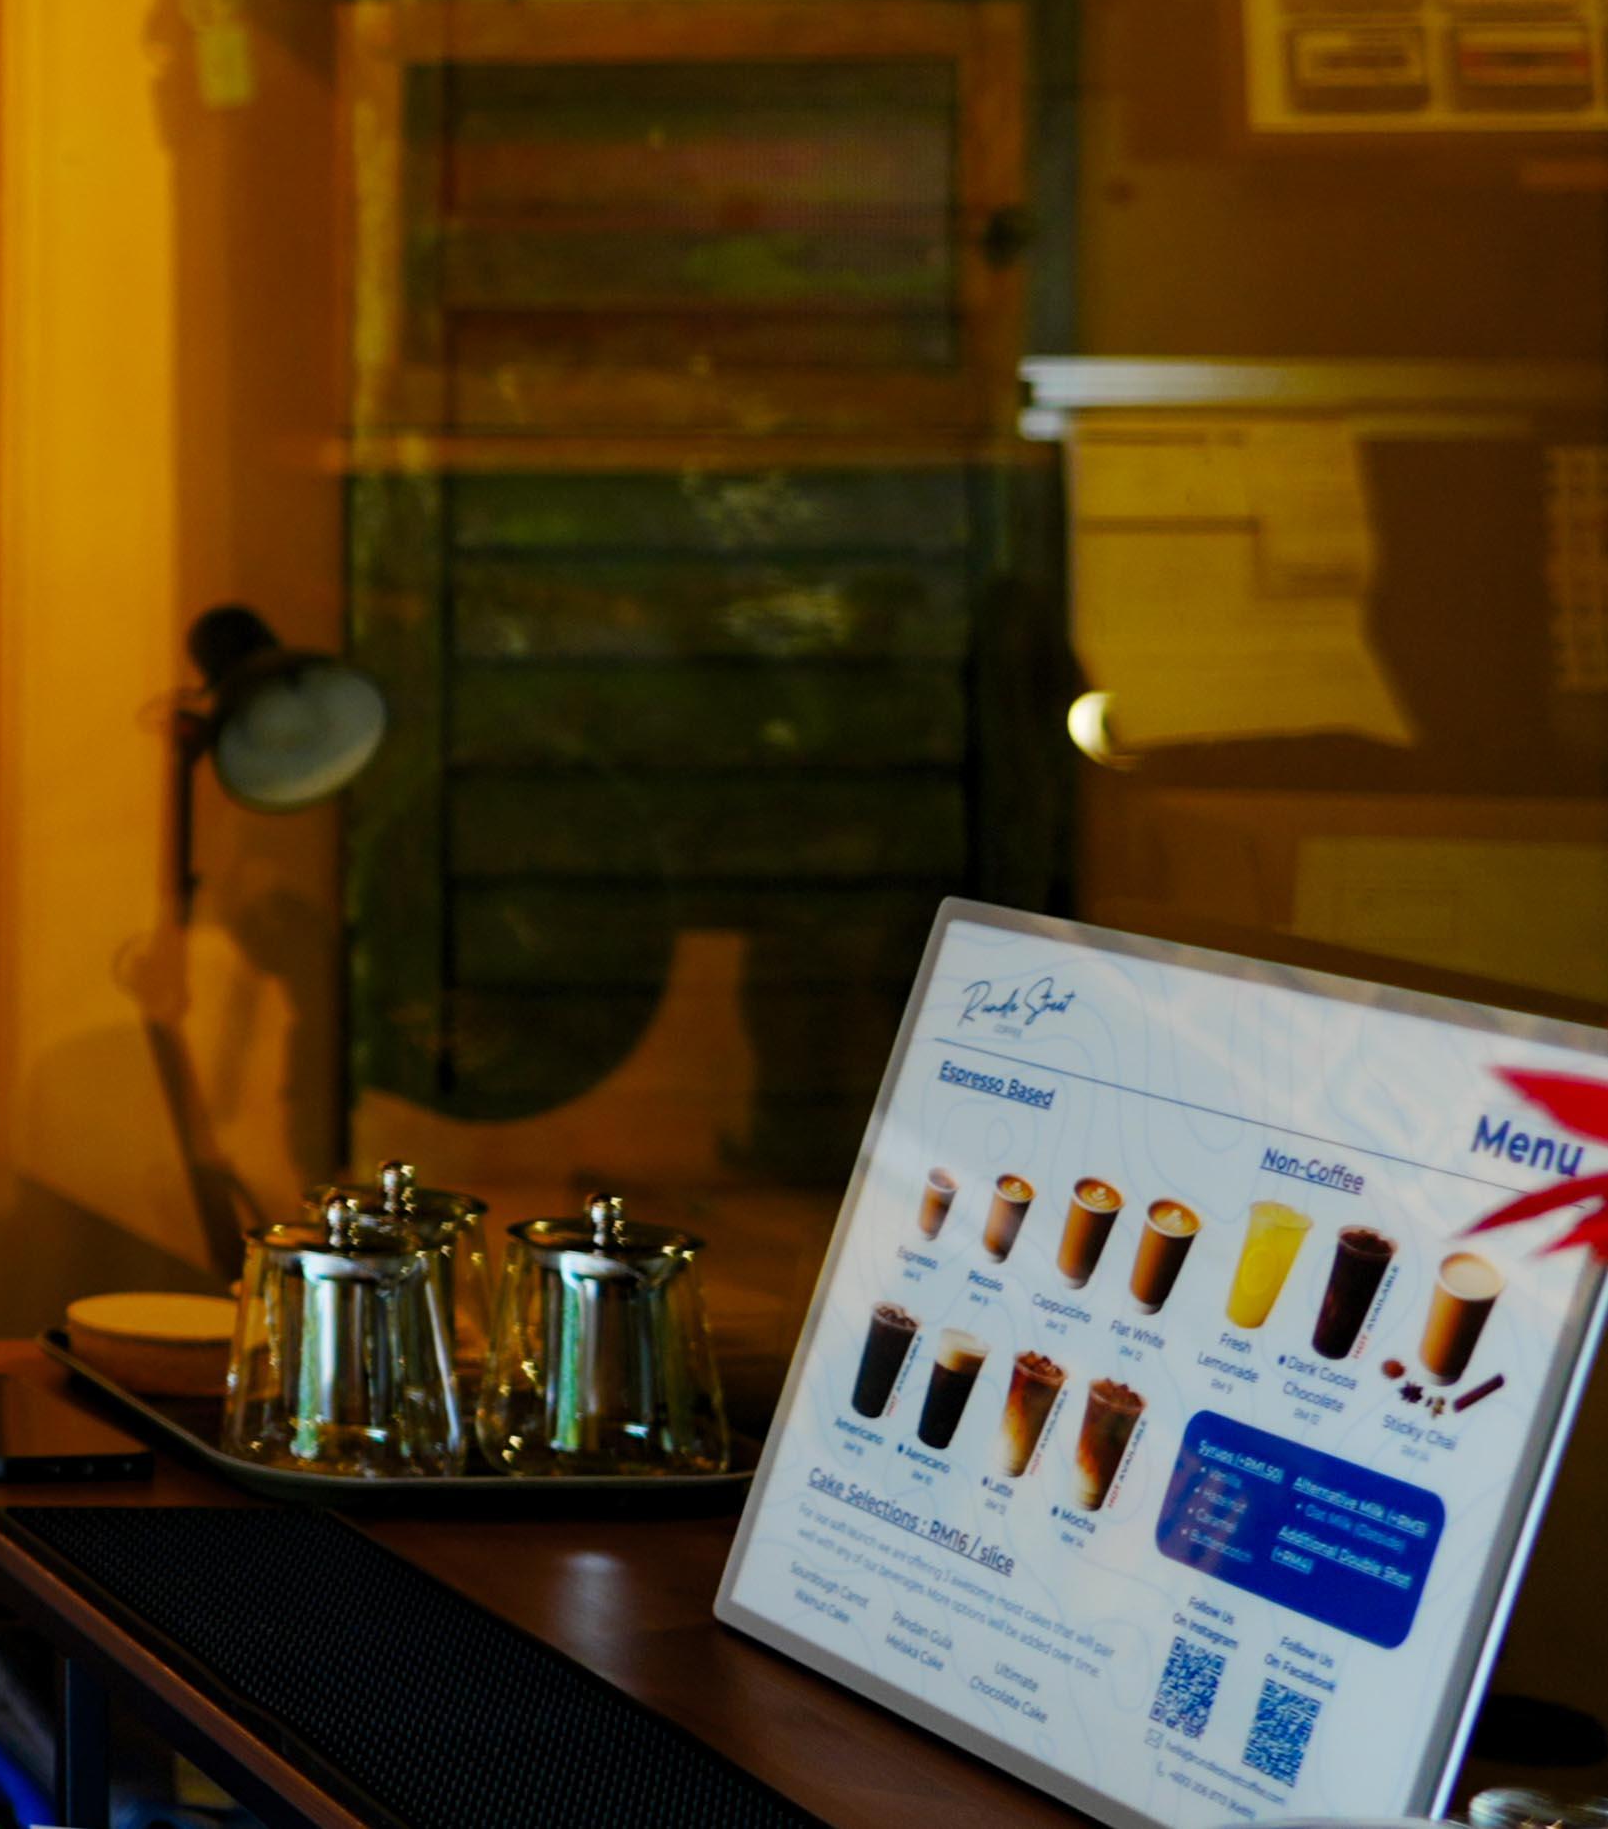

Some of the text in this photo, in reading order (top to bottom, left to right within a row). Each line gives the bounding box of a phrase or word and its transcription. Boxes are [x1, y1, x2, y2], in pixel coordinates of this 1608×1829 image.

[937, 1059, 1056, 1107] Espresso Based
[1469, 1114, 1587, 1176] Menu
[1261, 1146, 1367, 1192] Non-Coffee
[967, 1269, 1005, 1293] Piccolo
[1030, 1292, 1092, 1325] Cappuccino
[1353, 1265, 1400, 1359] HOT AVAILABLE
[1110, 1318, 1167, 1349] Flat White
[1218, 1333, 1252, 1355] Fresh
[895, 1334, 923, 1392] AVAILABLE
[1196, 1351, 1260, 1384] Lemonade
[1285, 1355, 1359, 1391] Dark Cocoa
[1281, 1380, 1346, 1414] Chocolate
[834, 1416, 885, 1446] Americano
[1038, 1388, 1069, 1452] AVAILABLE
[1380, 1414, 1458, 1452] Sticky Chai
[904, 1445, 952, 1475] Aerocano
[1117, 1419, 1148, 1480] AVAILABLE
[988, 1479, 1014, 1498] Latte
[1293, 1475, 1359, 1510] Alternative
[1358, 1499, 1385, 1519] Milk
[808, 1465, 846, 1496] Cake
[845, 1481, 921, 1530] Selections
[928, 1519, 969, 1552] RM16
[978, 1540, 1017, 1574] slice
[1060, 1509, 1097, 1534] Mocha
[1278, 1525, 1412, 1588] Additional Double Shot
[788, 1559, 870, 1610] Sourdough Carrot
[826, 1602, 851, 1625] Cake
[891, 1610, 954, 1651] Pandan Gula
[926, 1586, 951, 1606] More
[949, 1598, 987, 1625] options
[986, 1614, 1007, 1633] will
[1019, 1629, 1052, 1655] added
[1051, 1647, 1073, 1665] over
[949, 1573, 996, 1604] awesome
[1023, 1607, 1053, 1631] cakes
[1052, 1620, 1074, 1641] that
[1075, 1629, 1095, 1649] will
[1092, 1640, 1115, 1661] pair
[1187, 1595, 1236, 1626] Follow Us
[884, 1632, 946, 1673] Melaka Cake
[1171, 1611, 1240, 1653] On Instagram
[1279, 1635, 1336, 1669] Follow Us
[993, 1660, 1040, 1693] Ultimate
[1263, 1651, 1337, 1694] On Facebook
[968, 1673, 1050, 1725] Chocolate Cake
